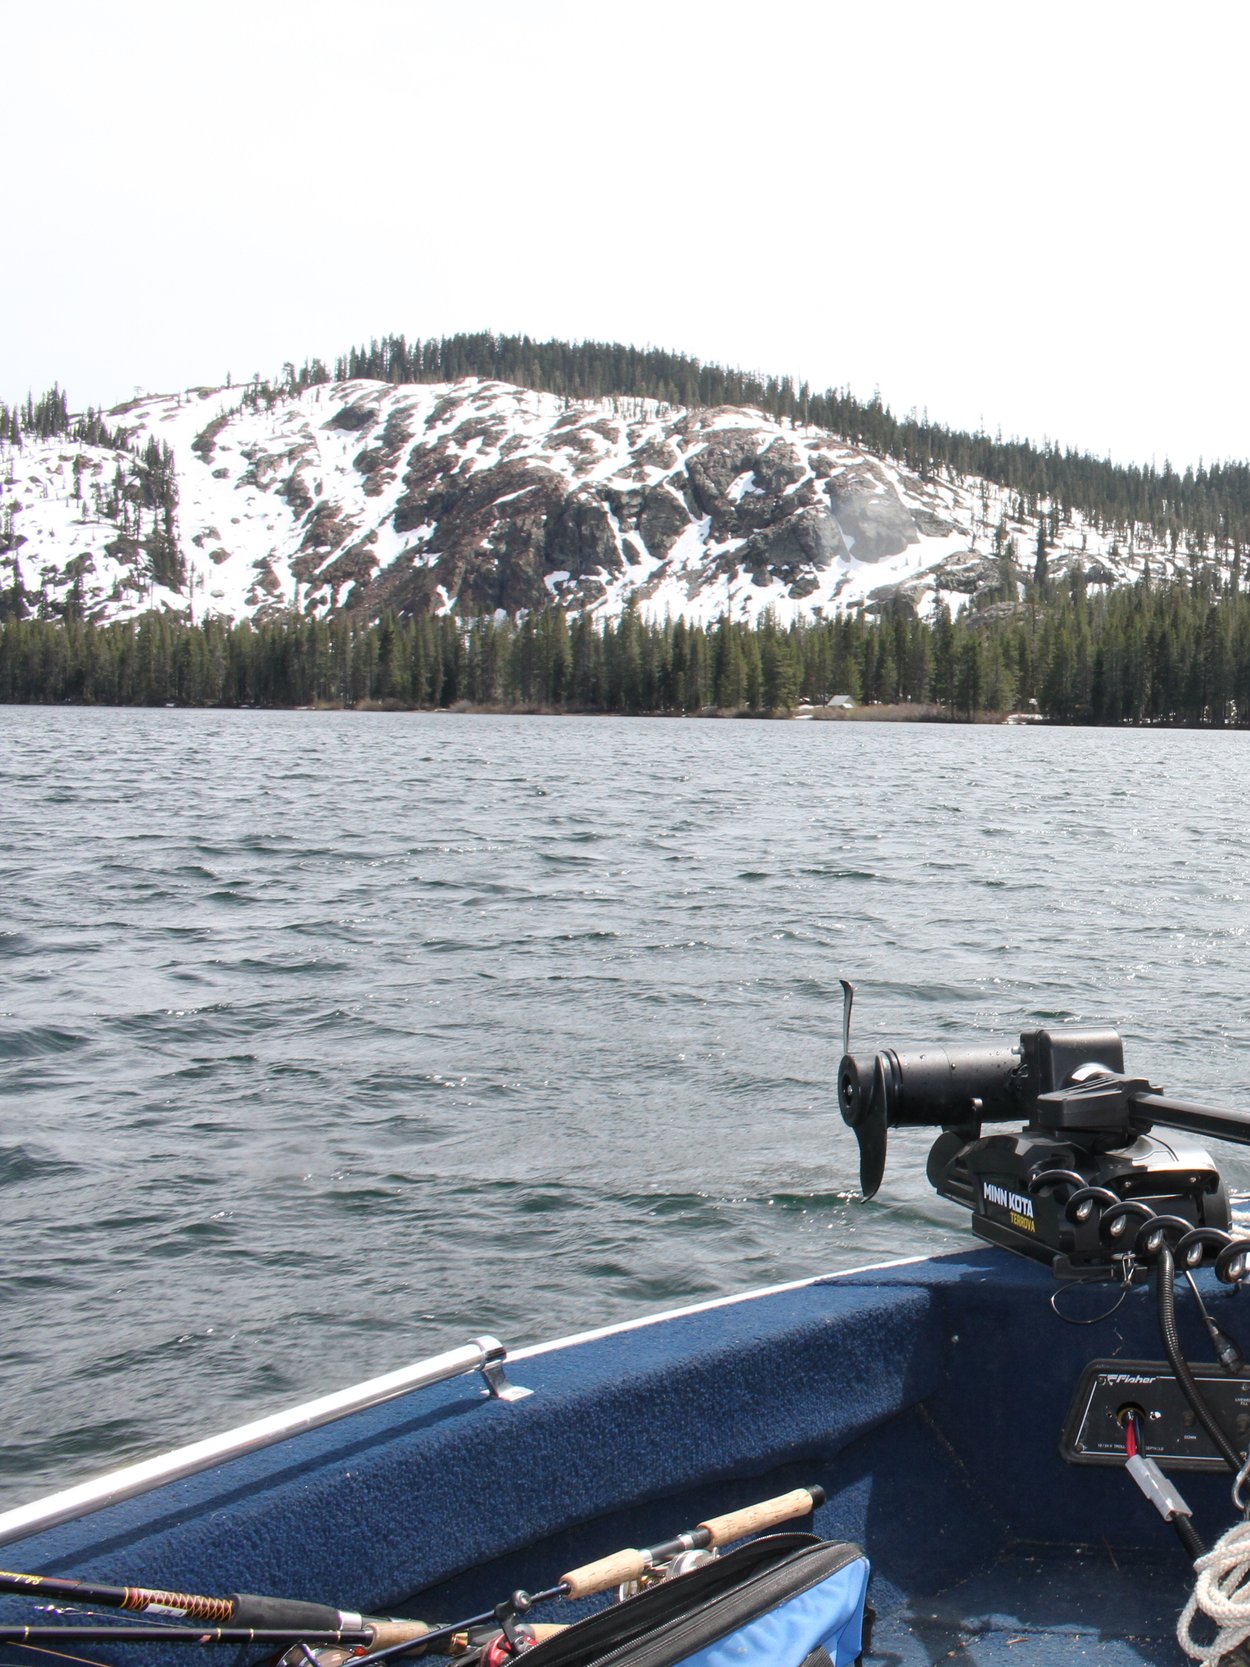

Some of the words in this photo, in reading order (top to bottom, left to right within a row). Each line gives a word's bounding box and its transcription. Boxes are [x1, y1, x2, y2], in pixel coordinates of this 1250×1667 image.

[983, 1181, 1008, 1207] MINN
[1008, 1192, 1034, 1219] KOTA
[1010, 1211, 1036, 1233] TERROVA
[1115, 1374, 1156, 1384] Fisher
